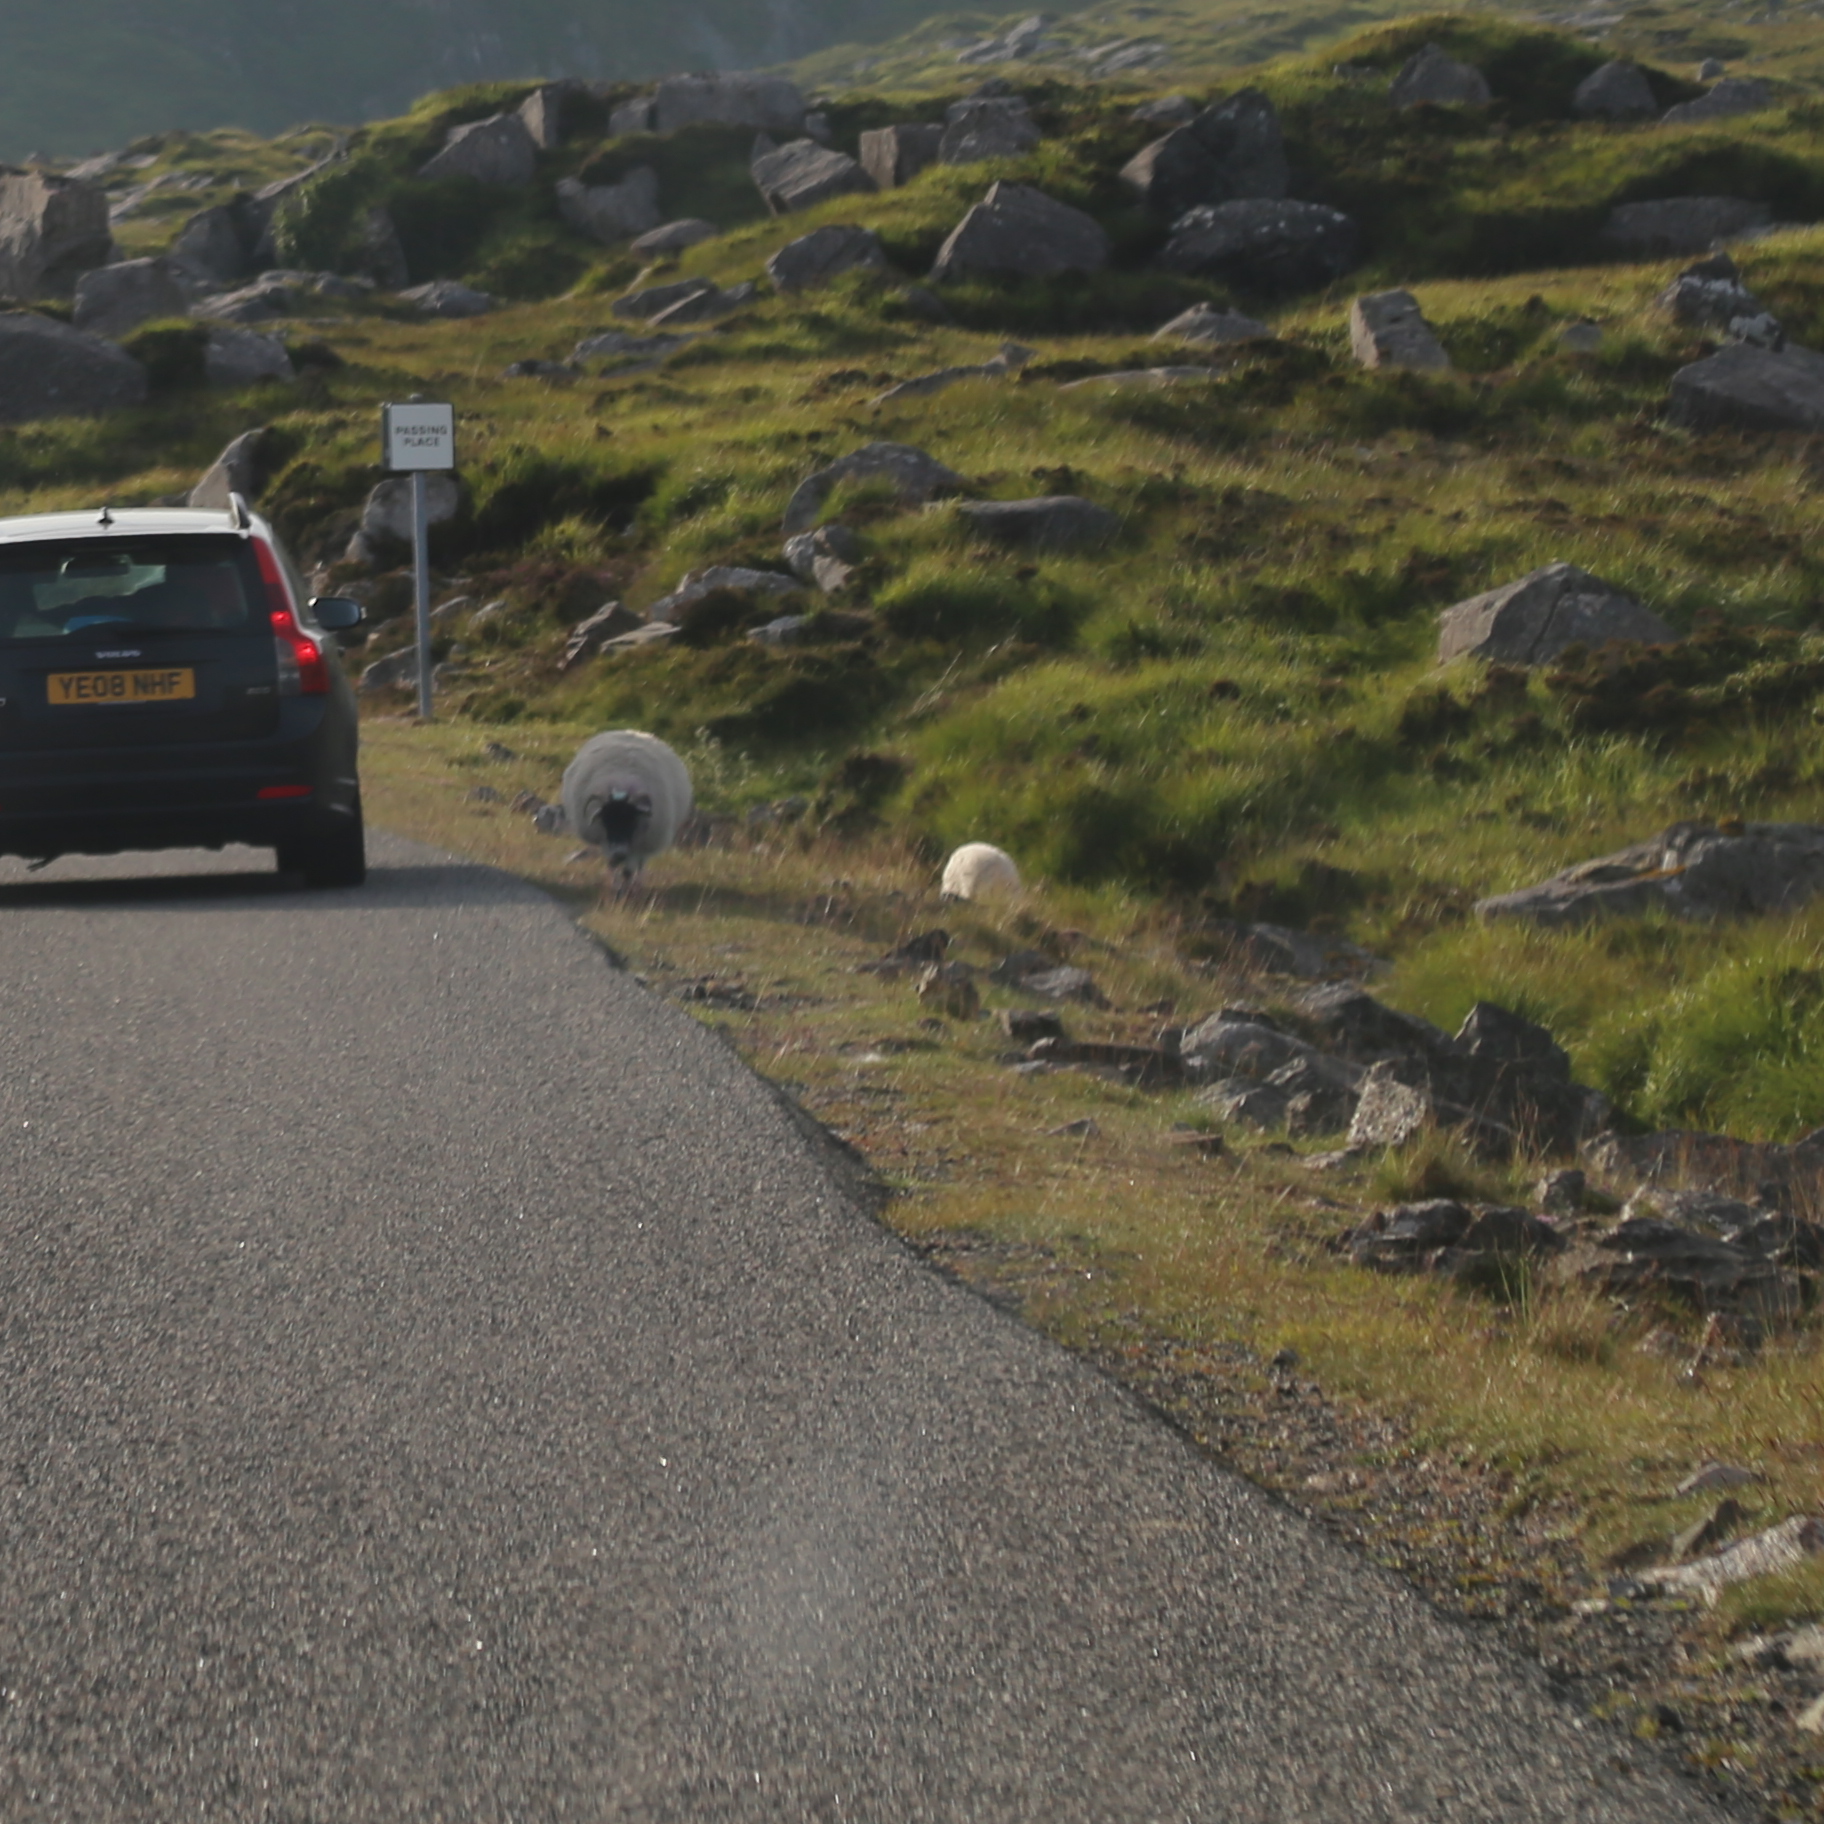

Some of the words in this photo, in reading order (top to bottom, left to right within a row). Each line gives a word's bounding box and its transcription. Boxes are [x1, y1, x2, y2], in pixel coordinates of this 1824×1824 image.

[396, 425, 447, 435] PASSING
[404, 437, 440, 447] PLACE
[59, 674, 125, 699] YE08
[133, 671, 182, 695] NHF
